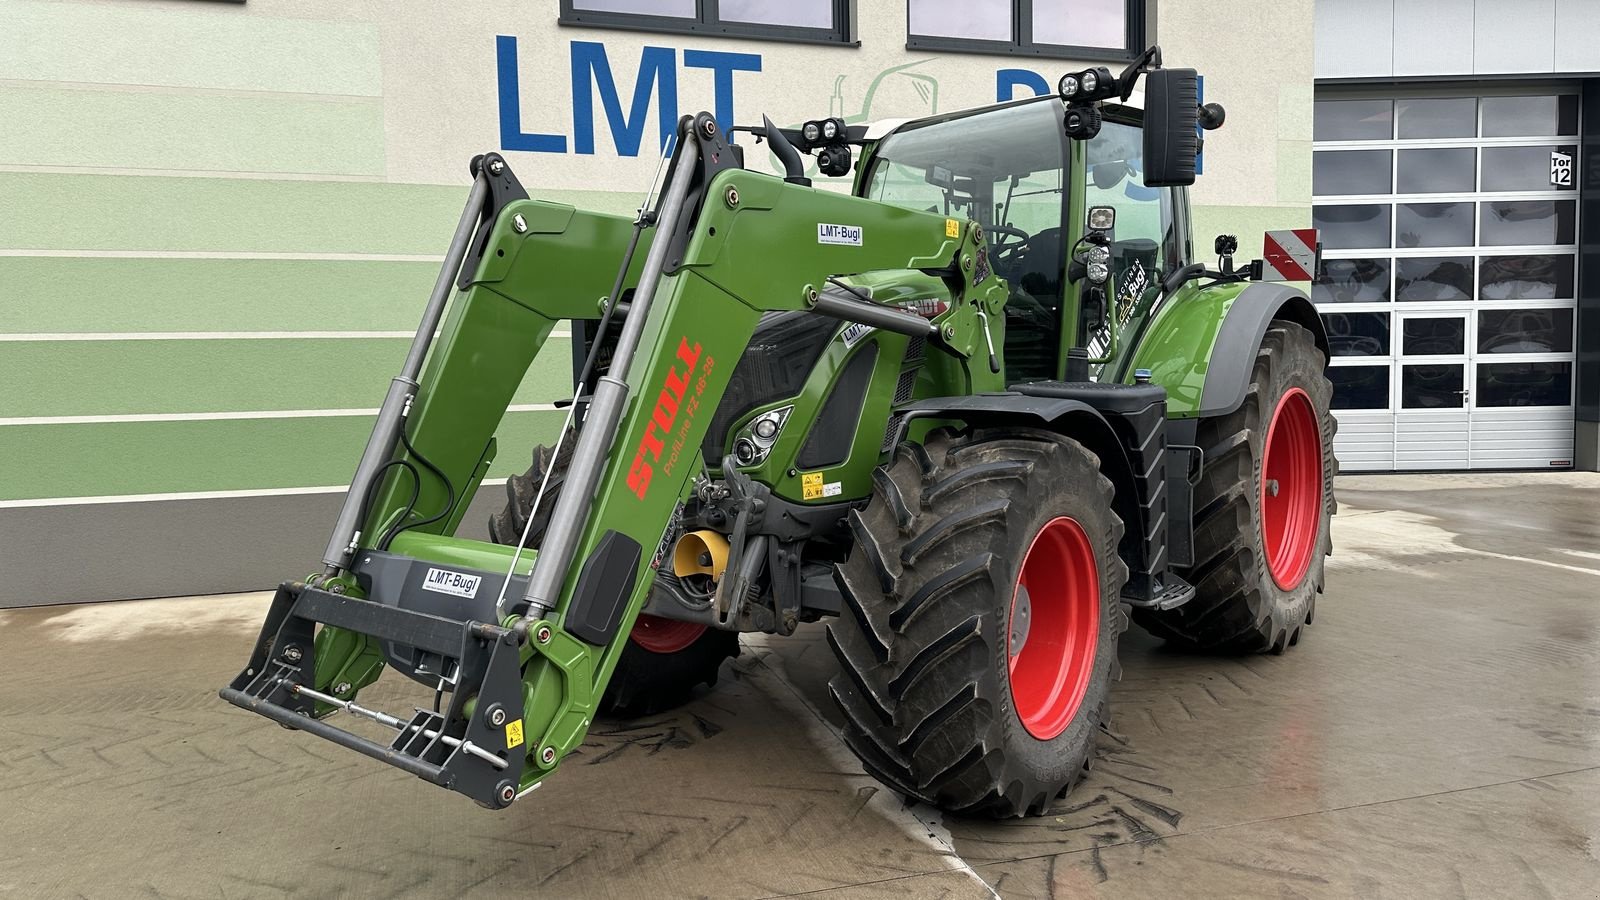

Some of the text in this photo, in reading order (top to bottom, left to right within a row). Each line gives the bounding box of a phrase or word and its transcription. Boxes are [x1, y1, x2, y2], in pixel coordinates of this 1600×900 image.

[496, 35, 762, 159] LMT
[1552, 158, 1570, 167] Tor
[1552, 168, 1570, 183] 12
[820, 225, 860, 242] LMT-Bugl
[1128, 264, 1147, 297] Bugl
[626, 335, 703, 501] STOLL
[663, 418, 692, 478] ProfiLine
[686, 395, 699, 418] FZ
[428, 569, 478, 593] LMT-Bugl
